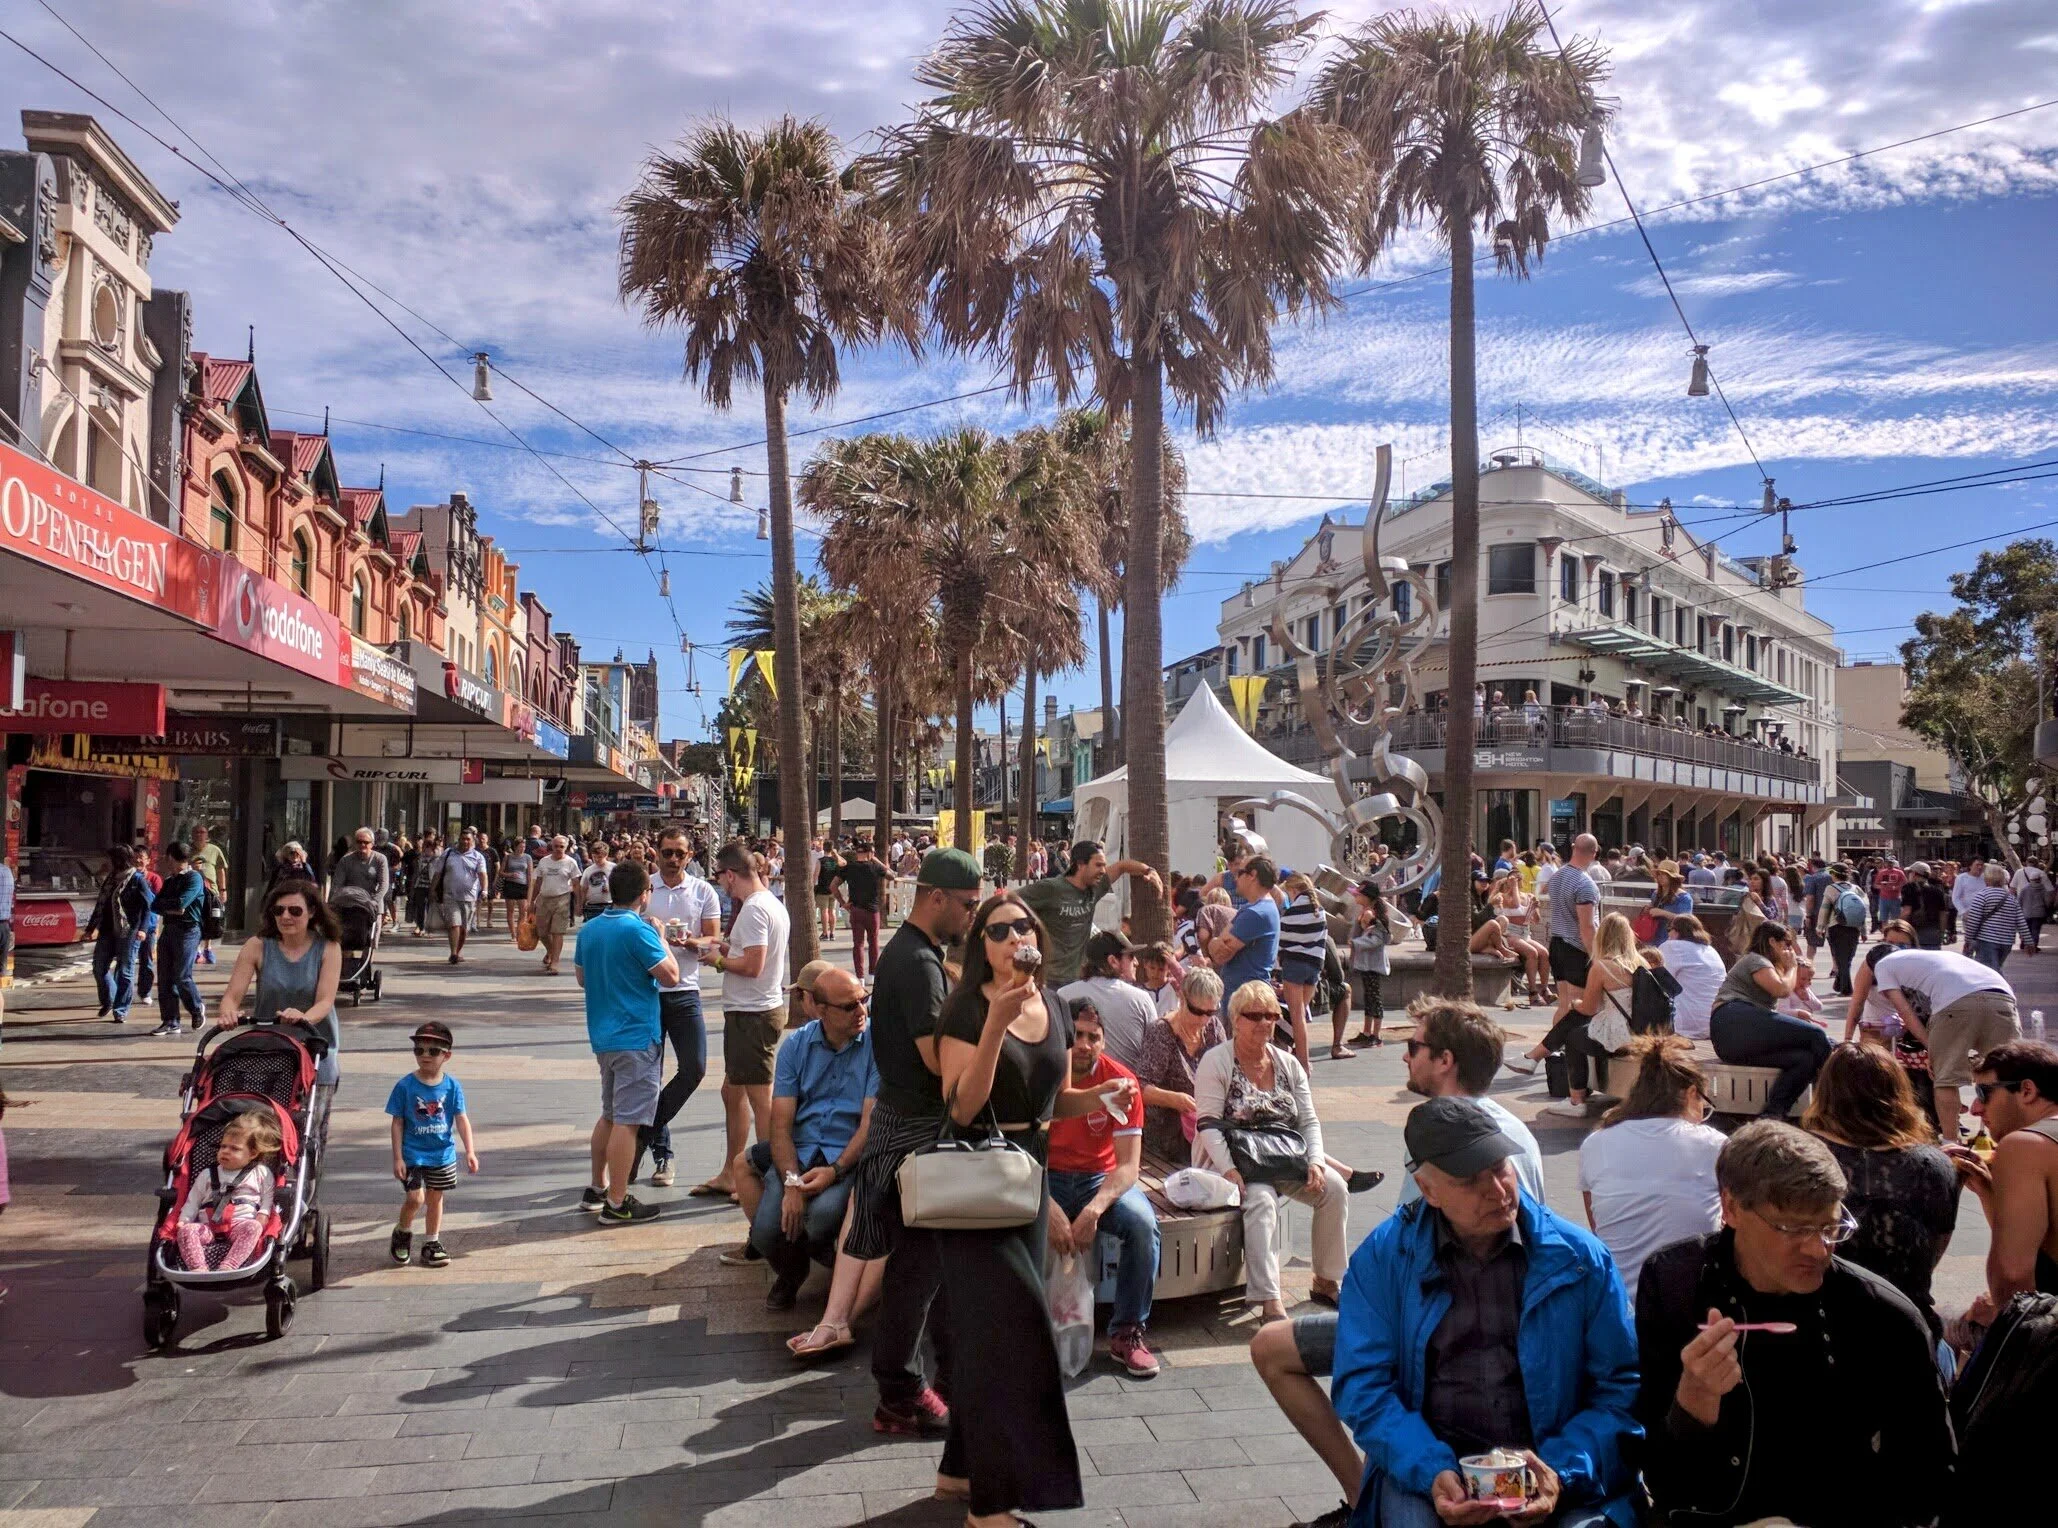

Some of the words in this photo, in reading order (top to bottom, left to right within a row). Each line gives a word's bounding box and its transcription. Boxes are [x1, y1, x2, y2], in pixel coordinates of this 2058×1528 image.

[1, 477, 168, 598] OPENHAGEN
[260, 600, 323, 660] vodafone
[397, 665, 414, 692] Kebabs
[461, 678, 475, 701] RIP
[353, 770, 384, 779] RIP
[385, 771, 430, 780] CURL
